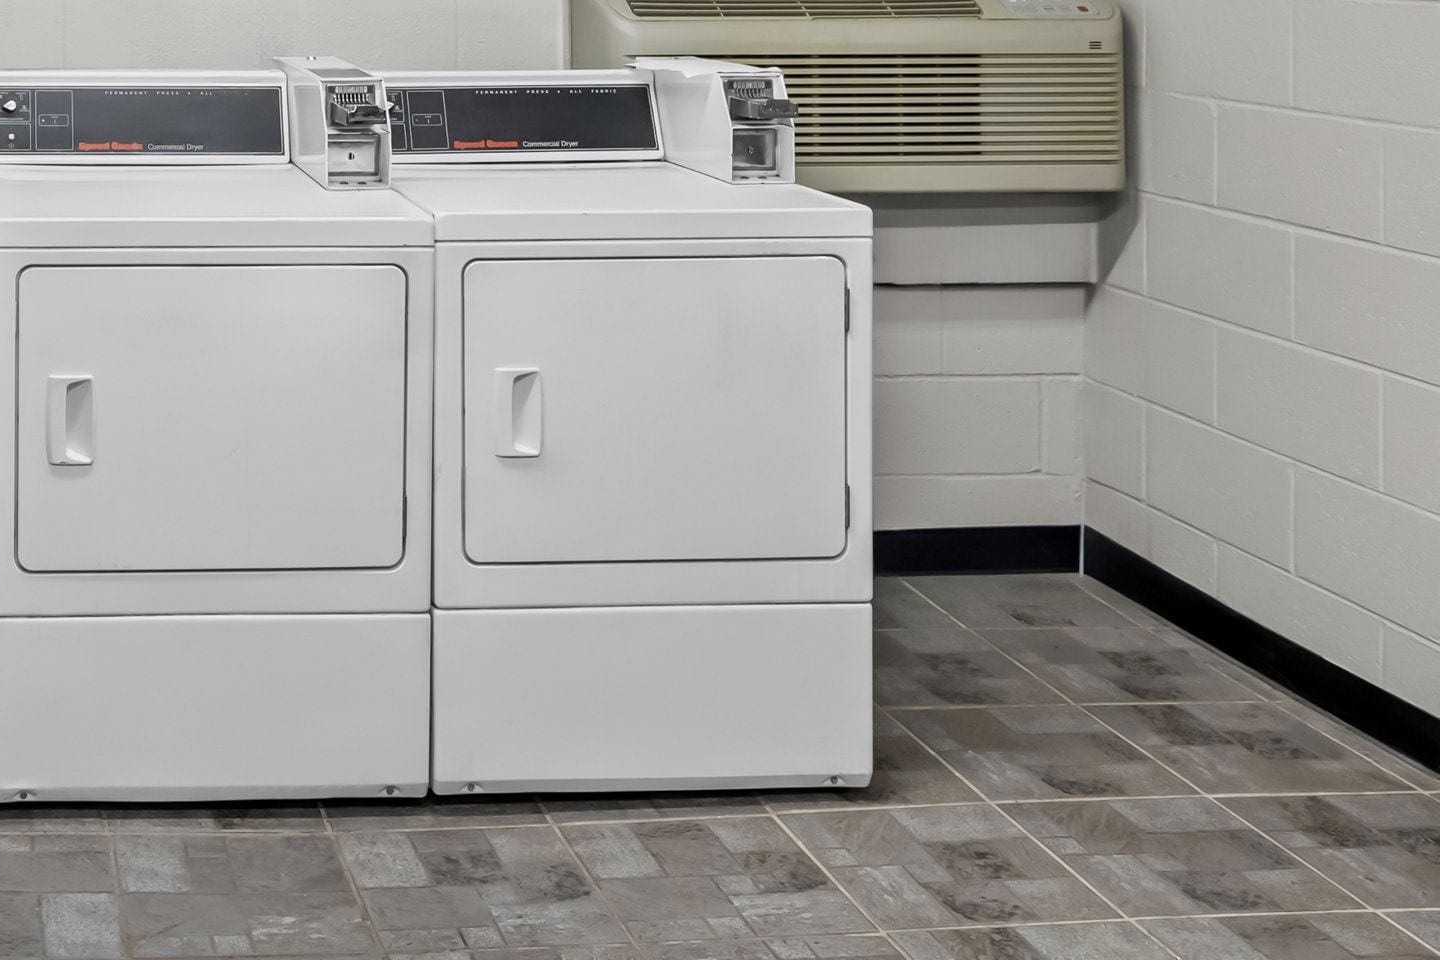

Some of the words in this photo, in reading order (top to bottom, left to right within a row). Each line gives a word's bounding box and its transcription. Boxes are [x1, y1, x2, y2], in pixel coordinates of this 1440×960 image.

[147, 143, 185, 151] Commercial
[186, 143, 204, 151] Dryer
[522, 140, 559, 148] Commercial
[561, 140, 579, 148] Dryer
